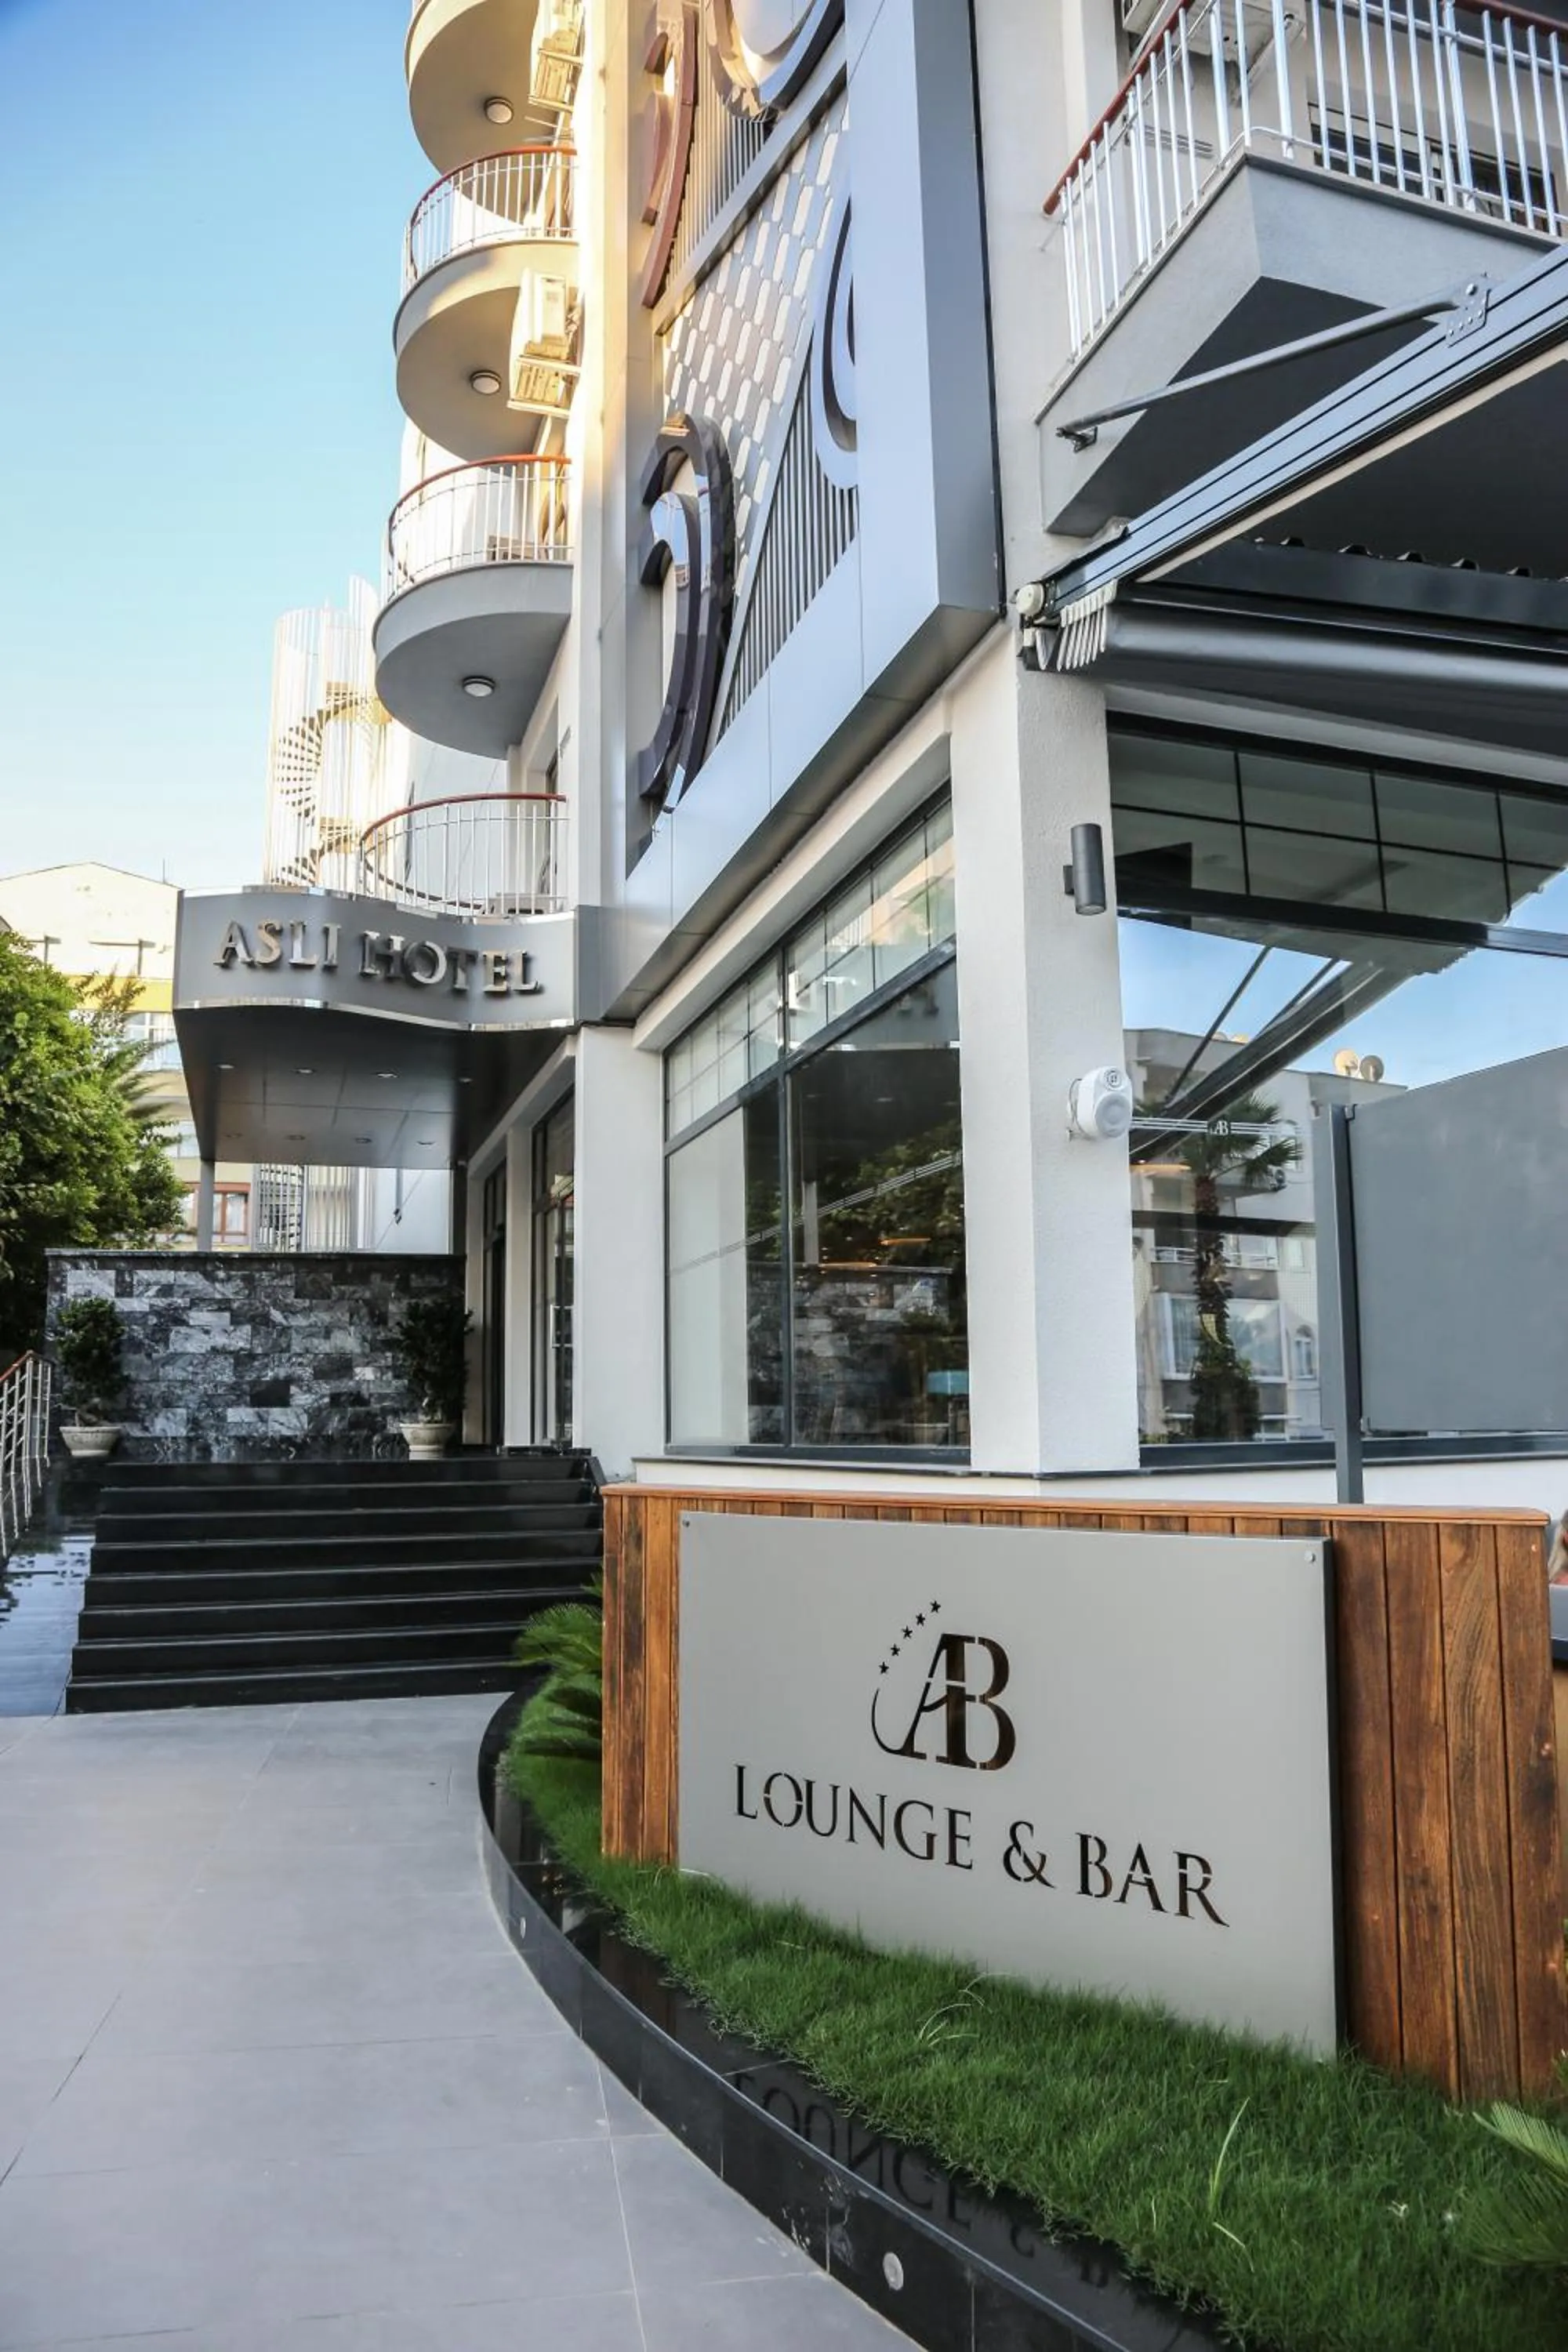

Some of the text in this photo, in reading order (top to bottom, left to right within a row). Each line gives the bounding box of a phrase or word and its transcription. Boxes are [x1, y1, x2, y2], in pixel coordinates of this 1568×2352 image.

[213, 920, 541, 993] ASLI HOTEL
[871, 1633, 1016, 1770] AB
[734, 1765, 1230, 1928] LOUNGE & BAR
